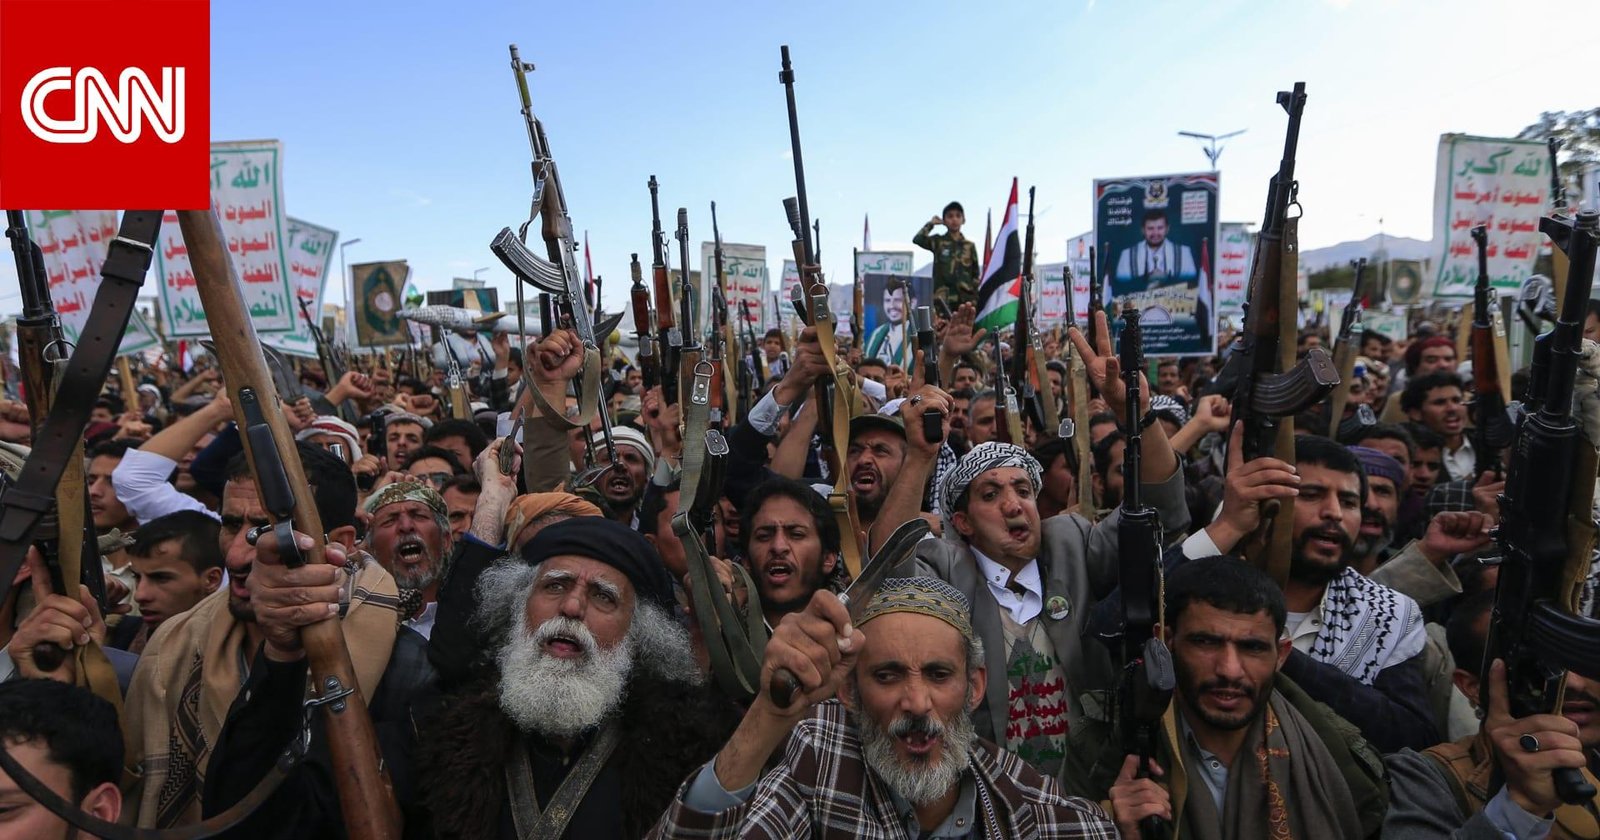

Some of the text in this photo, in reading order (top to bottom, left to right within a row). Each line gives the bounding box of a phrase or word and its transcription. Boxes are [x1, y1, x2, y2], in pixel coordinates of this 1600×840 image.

[231, 160, 270, 188] الله
[1457, 147, 1550, 179] الله أكبر
[1502, 188, 1545, 207] الموت
[225, 200, 272, 224] الموت
[228, 231, 275, 256] الموت
[301, 234, 329, 256] الله
[242, 263, 280, 284] اللعنة
[742, 263, 763, 278] الله
[861, 256, 909, 272] الله أكبر
